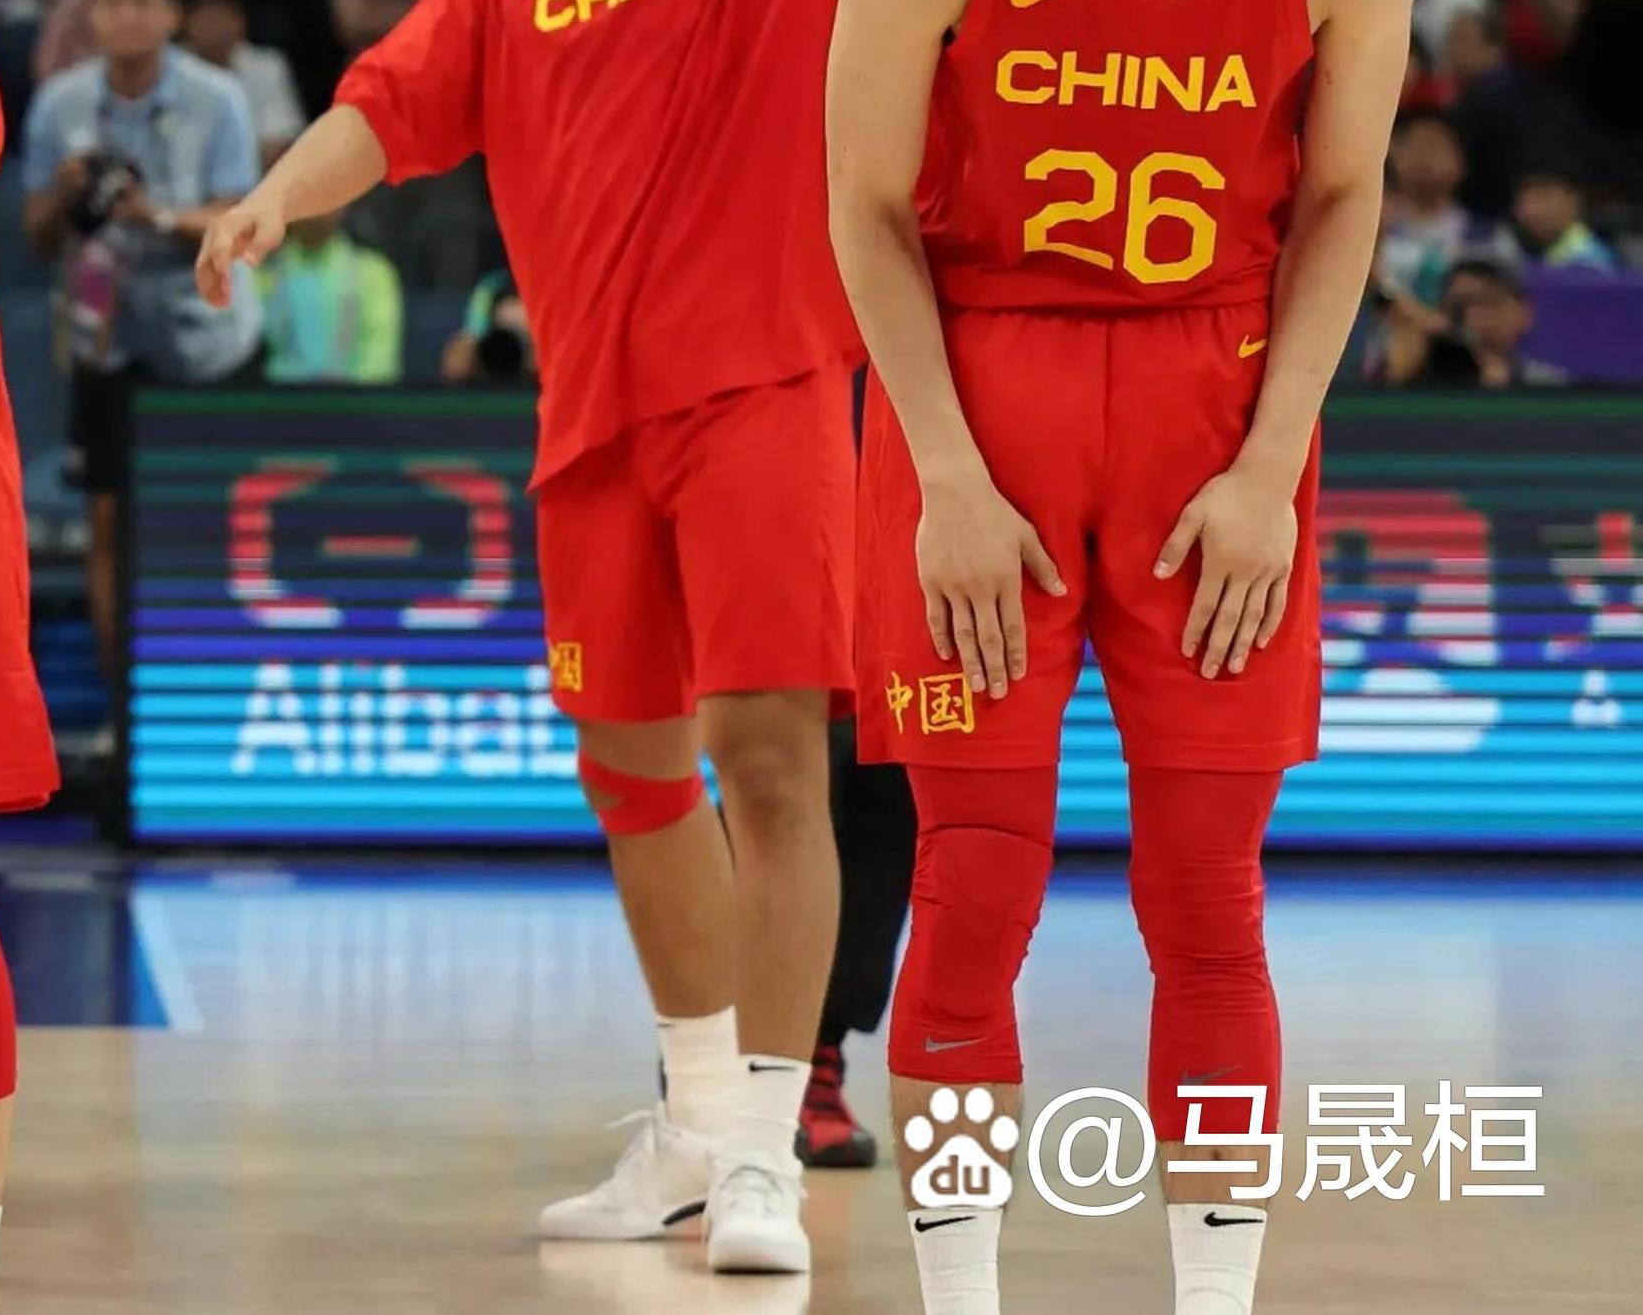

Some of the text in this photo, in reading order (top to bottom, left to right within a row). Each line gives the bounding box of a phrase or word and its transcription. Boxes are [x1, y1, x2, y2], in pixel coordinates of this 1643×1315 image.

[995, 50, 1257, 112] CHINA
[1024, 148, 1226, 284] 26
[884, 670, 975, 735] 中国
